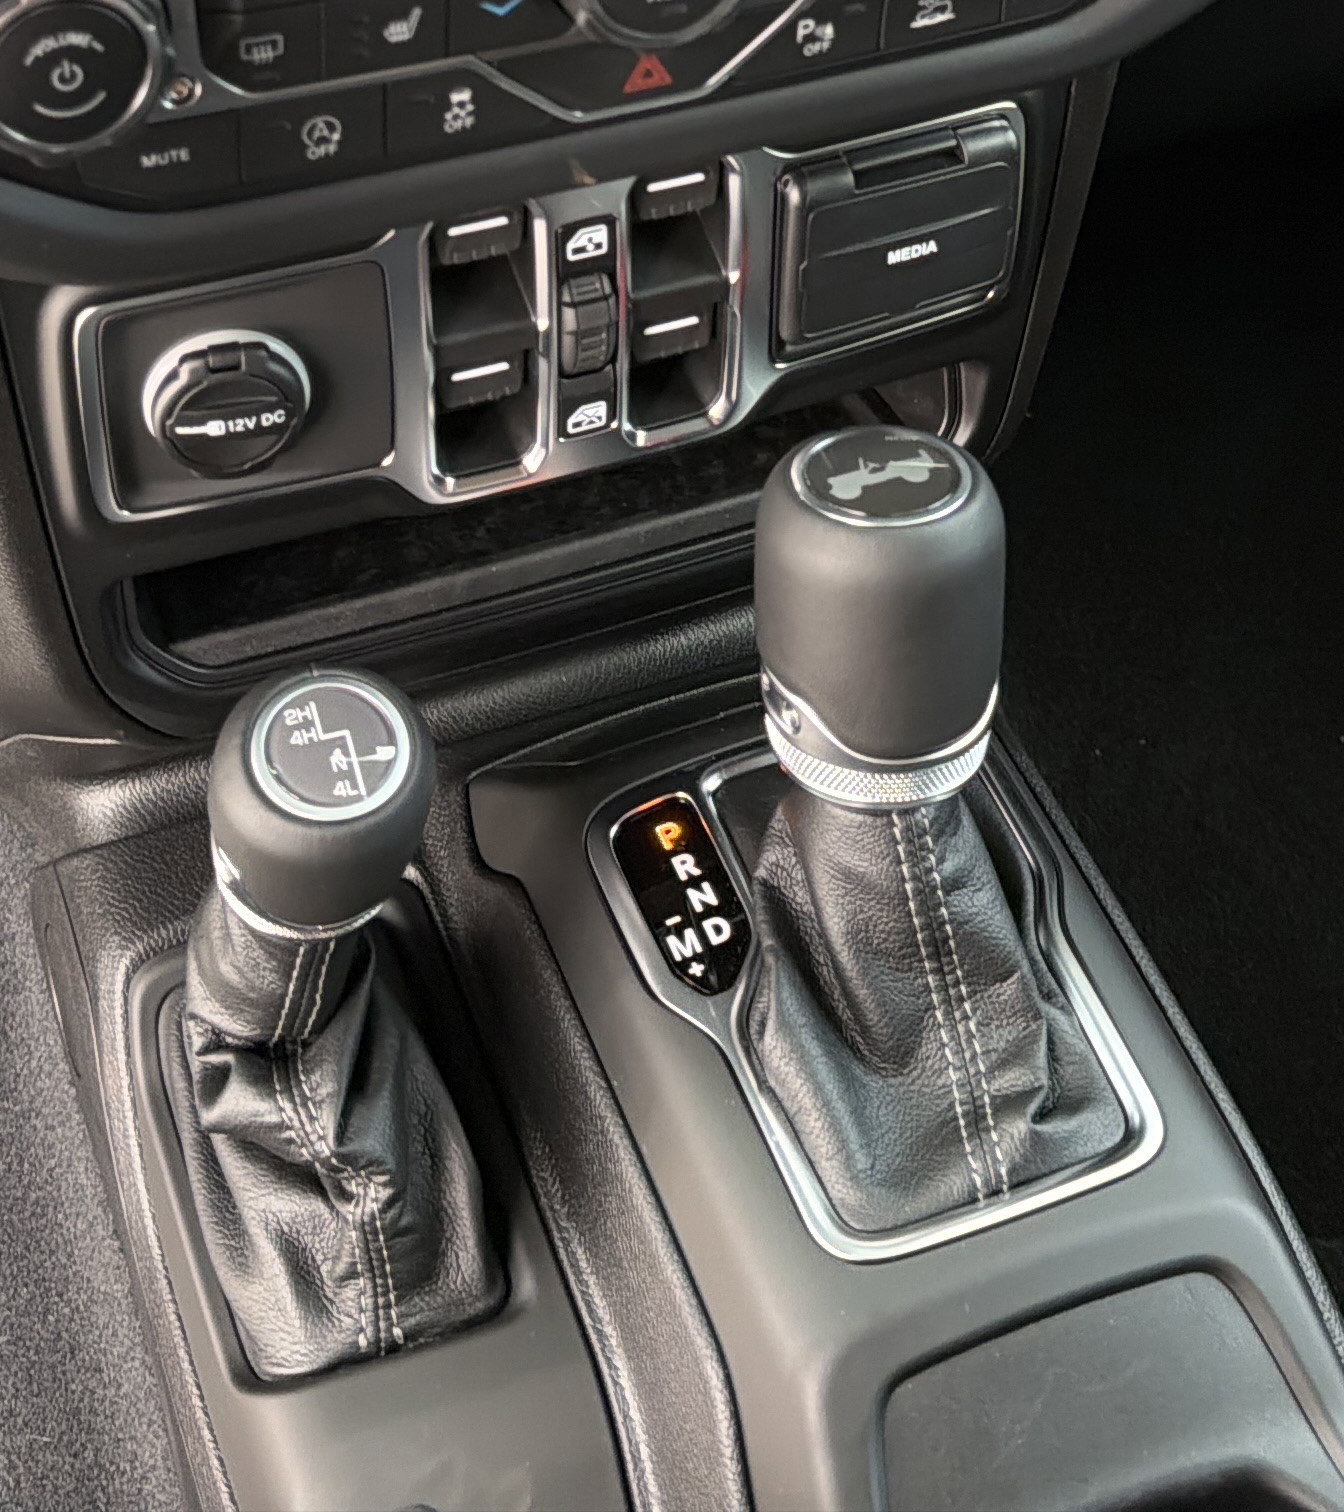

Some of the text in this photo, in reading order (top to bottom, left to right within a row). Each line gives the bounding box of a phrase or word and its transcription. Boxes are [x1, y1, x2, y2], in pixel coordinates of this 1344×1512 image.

[34, 31, 94, 58] VOLUME
[802, 38, 832, 57] OFF
[443, 112, 475, 134] OFF
[140, 146, 191, 169] MUTE
[306, 142, 339, 160] OFF
[886, 239, 938, 266] MEDIA
[226, 409, 286, 433] 12V DC
[283, 704, 312, 726] 2H
[289, 726, 317, 746] 4H
[330, 752, 348, 773] N
[333, 780, 360, 798] 4L
[655, 821, 682, 851] P
[671, 853, 702, 881] R
[686, 882, 718, 912] N
[702, 916, 732, 946] D
[666, 927, 703, 962] M
